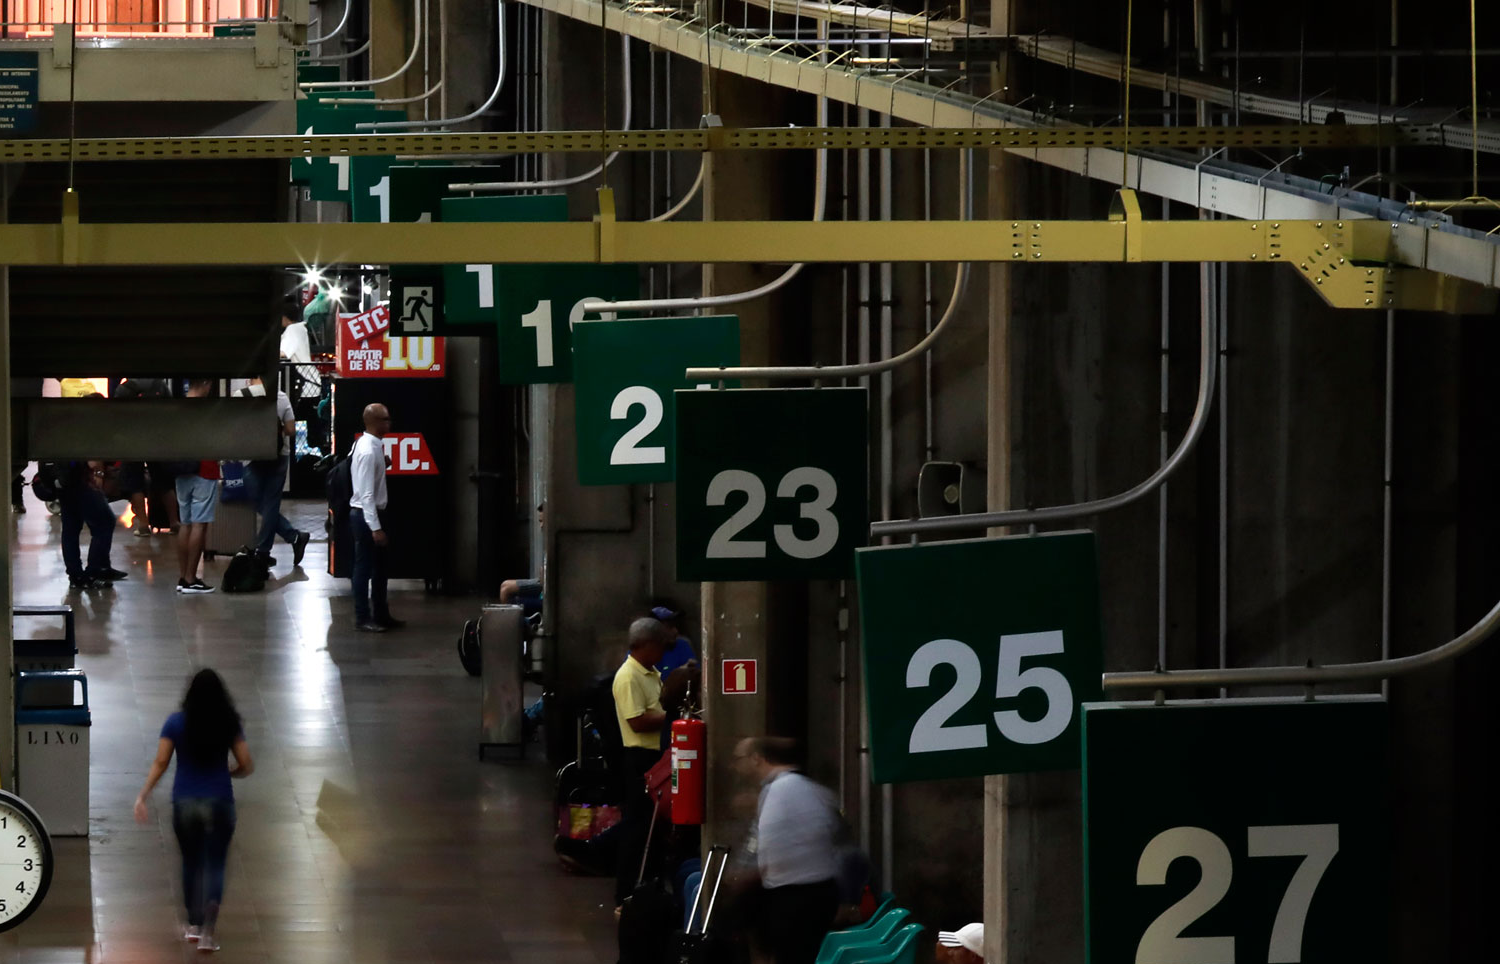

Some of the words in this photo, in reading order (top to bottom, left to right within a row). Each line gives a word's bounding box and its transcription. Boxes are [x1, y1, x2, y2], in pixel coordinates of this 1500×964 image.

[347, 307, 389, 340] ETC
[347, 349, 384, 360] PARTIR
[349, 360, 363, 371] DE
[382, 437, 430, 470] TC.
[705, 466, 840, 560] 23
[904, 629, 1075, 755] 25
[28, 731, 79, 745] LIXO
[0, 816, 7, 829] 1
[16, 835, 27, 848] 2
[23, 858, 33, 872] 3
[15, 880, 26, 894] 4
